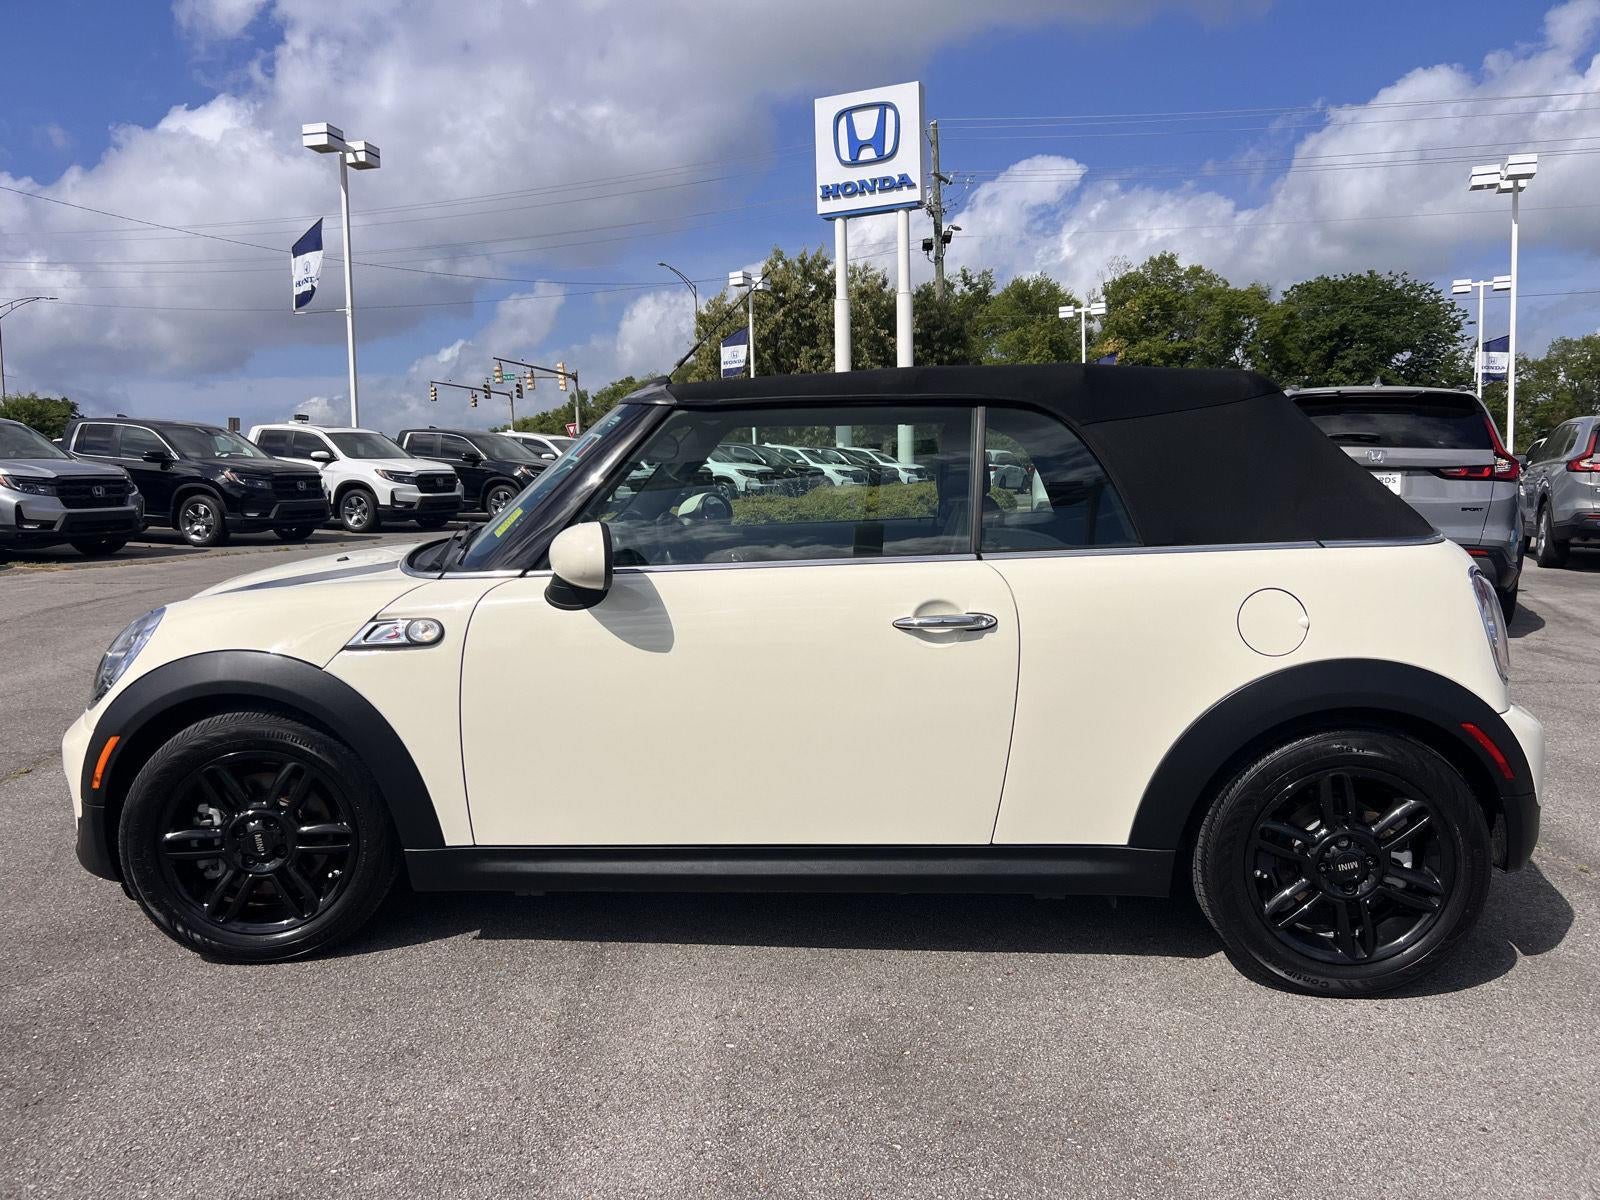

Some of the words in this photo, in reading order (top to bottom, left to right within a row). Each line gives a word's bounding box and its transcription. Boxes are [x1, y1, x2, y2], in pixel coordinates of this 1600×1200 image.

[820, 173, 917, 201] HONDA
[254, 833, 265, 852] MINI
[1337, 860, 1359, 872] MINI
